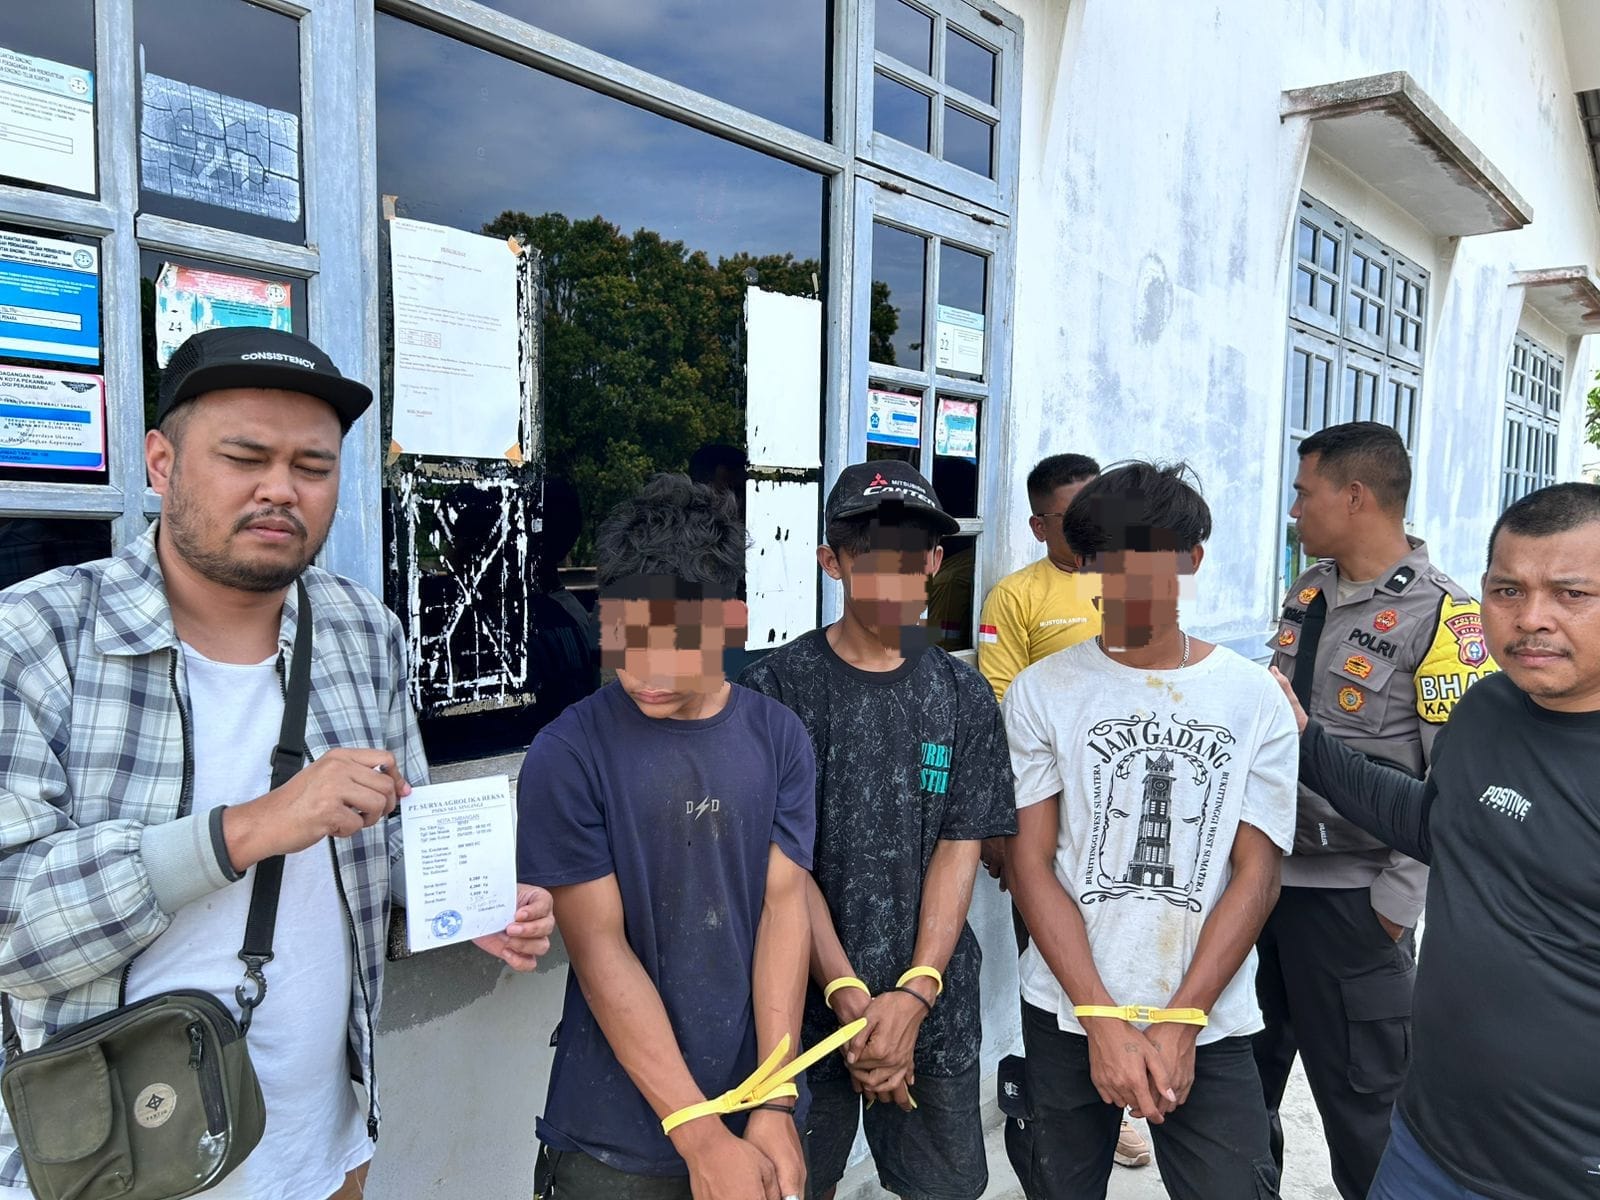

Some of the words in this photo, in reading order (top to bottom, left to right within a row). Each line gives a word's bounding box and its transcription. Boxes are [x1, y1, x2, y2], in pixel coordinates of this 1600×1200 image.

[241, 351, 315, 369] CONSISTENCY
[1349, 628, 1397, 659] POLRI
[1425, 700, 1456, 715] KA
[1087, 727, 1138, 764] JAM
[1142, 721, 1232, 770] GADANG
[1093, 764, 1101, 809] SUMATERA
[420, 802, 443, 810] SURYA
[1482, 785, 1532, 816] POSITIVE
[1093, 810, 1101, 833] WEST
[1205, 826, 1217, 849] WEST
[1195, 849, 1211, 892] SUMATERA
